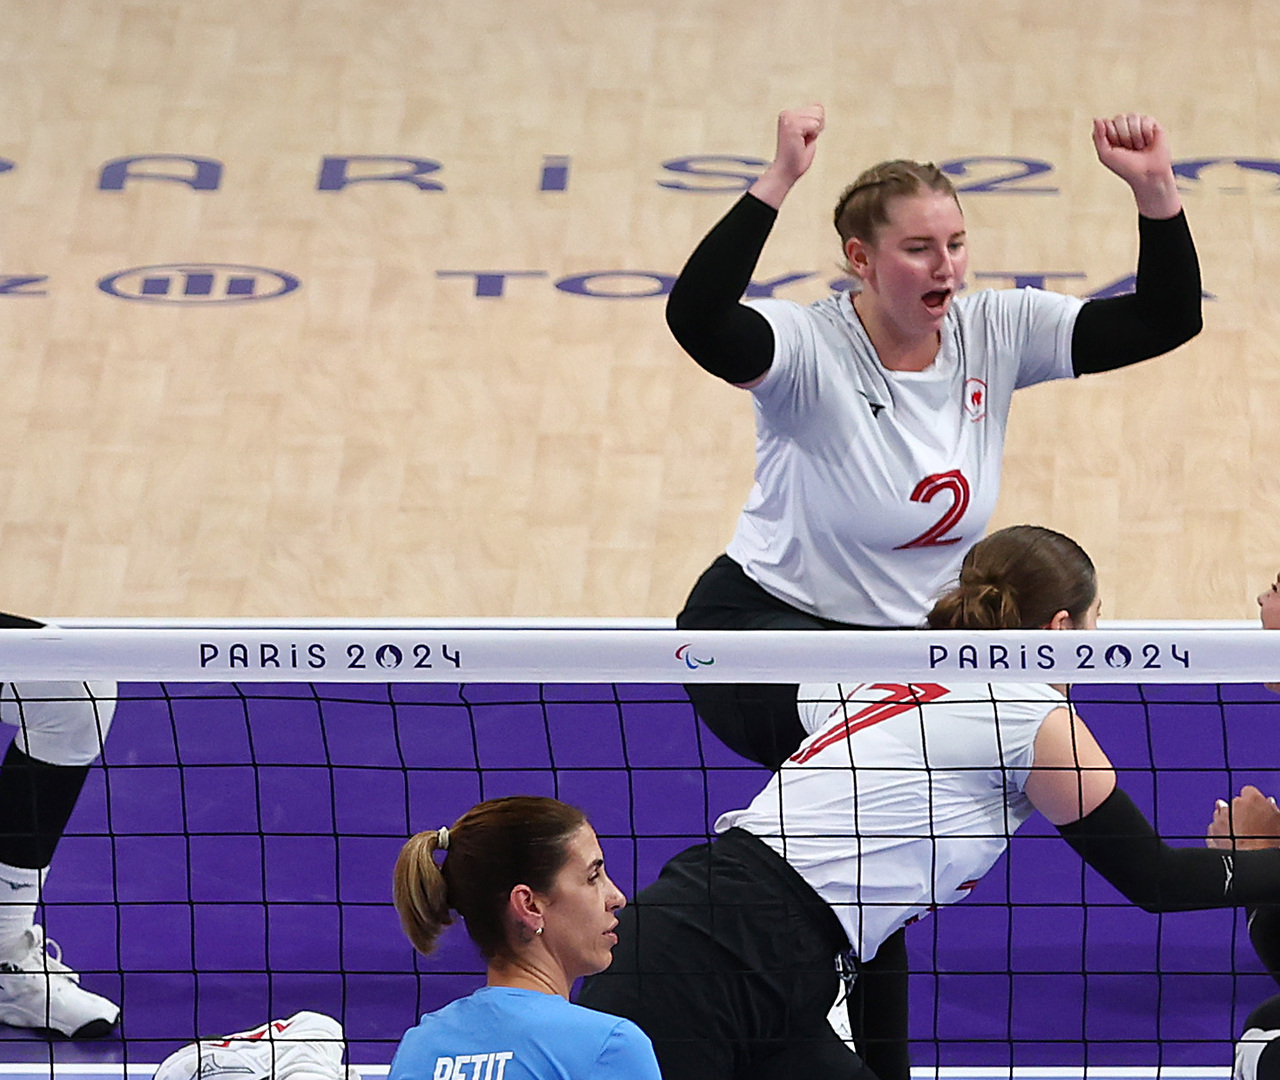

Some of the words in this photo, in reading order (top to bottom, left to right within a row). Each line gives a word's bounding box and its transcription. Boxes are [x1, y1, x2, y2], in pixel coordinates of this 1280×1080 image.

[434, 270, 1218, 300] TOYT
[892, 469, 970, 550] 2
[346, 643, 462, 669] 2024
[1076, 643, 1191, 670] 2024
